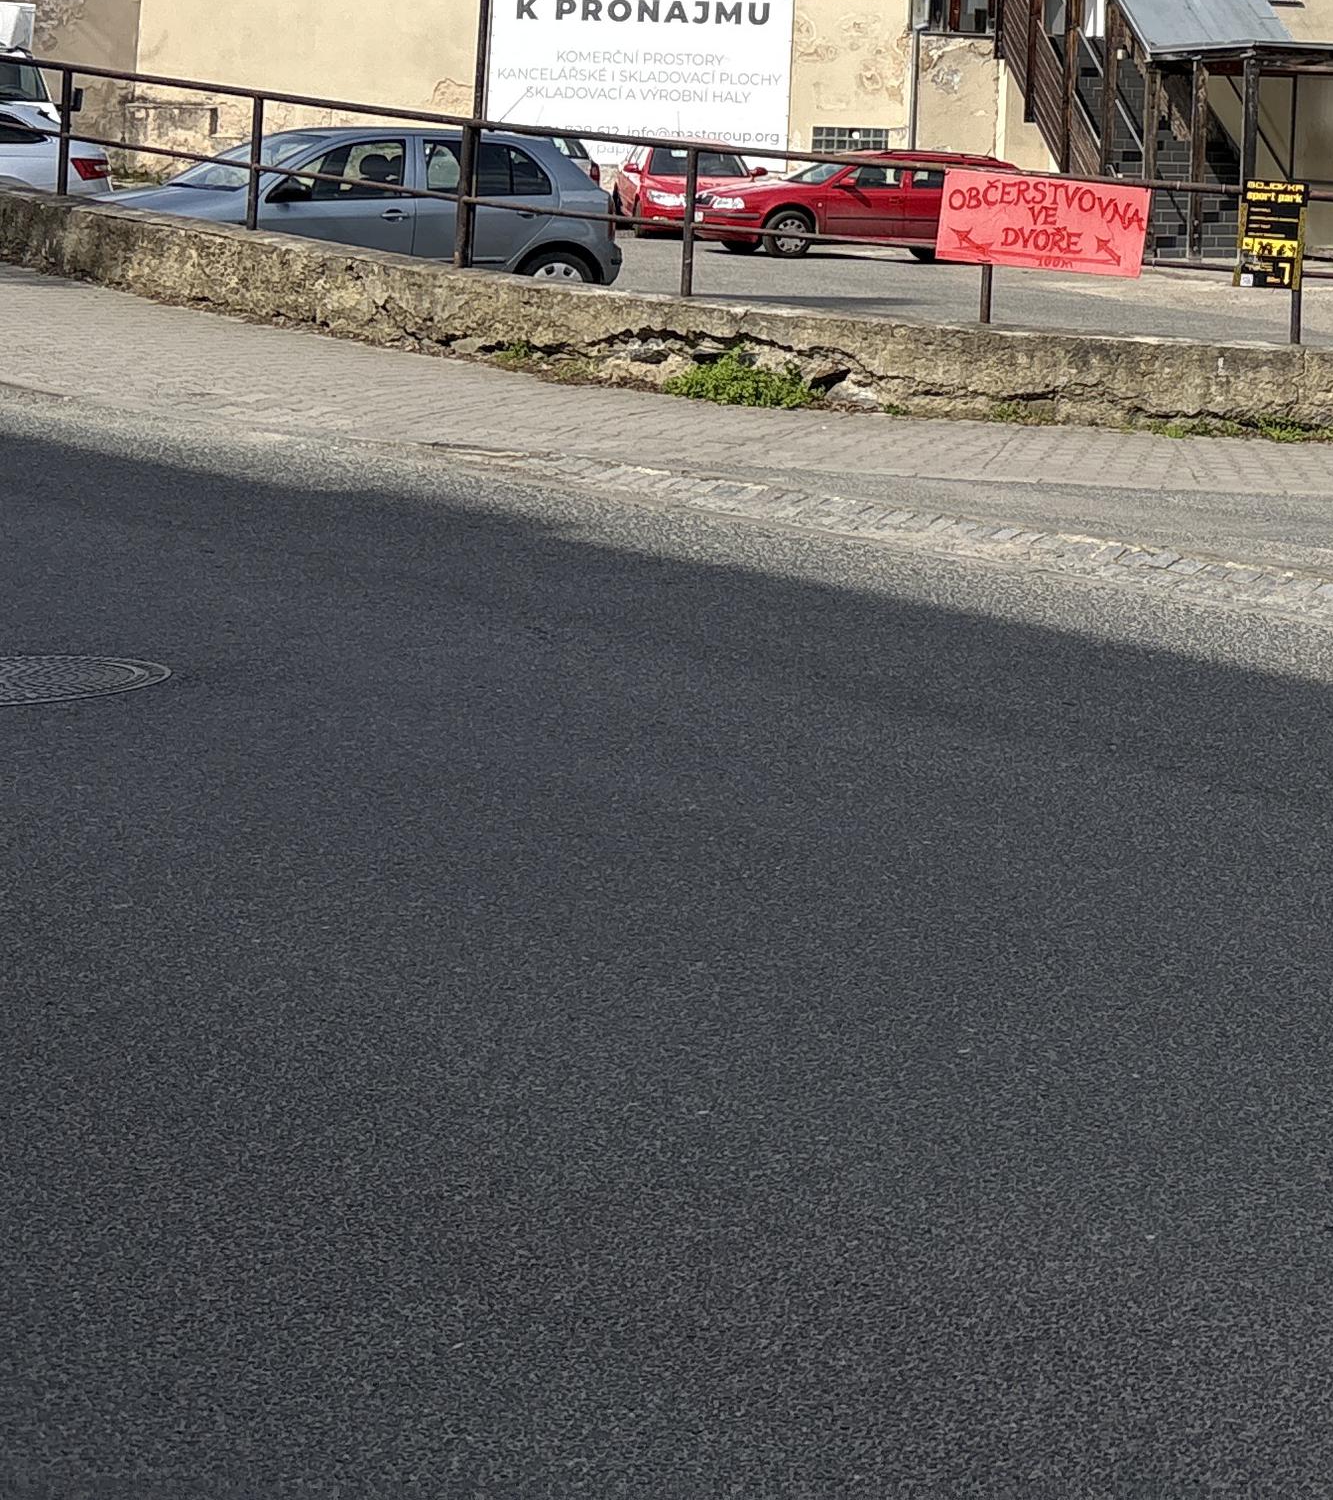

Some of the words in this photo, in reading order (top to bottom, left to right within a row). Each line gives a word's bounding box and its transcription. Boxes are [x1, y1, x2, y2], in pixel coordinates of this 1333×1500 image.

[556, 49, 639, 65] KOMERČNÍ
[643, 52, 724, 66] PROSTORY
[498, 67, 606, 82] KANCELÁŘSKÉ
[619, 69, 716, 85] SKLADOVACÍ
[720, 72, 782, 86] PLOCHY
[525, 86, 623, 101] SKLADOVACÍ
[627, 89, 637, 101] A
[640, 86, 708, 102] VÝROBNÍ
[713, 90, 752, 104] HALY
[949, 179, 1146, 232] OBČERSTVOVNA
[1246, 191, 1277, 202] sport
[1277, 193, 1303, 204] park
[1028, 205, 1057, 226] VE
[1001, 226, 1083, 254] DVOŘE
[1037, 256, 1073, 269] 100m
